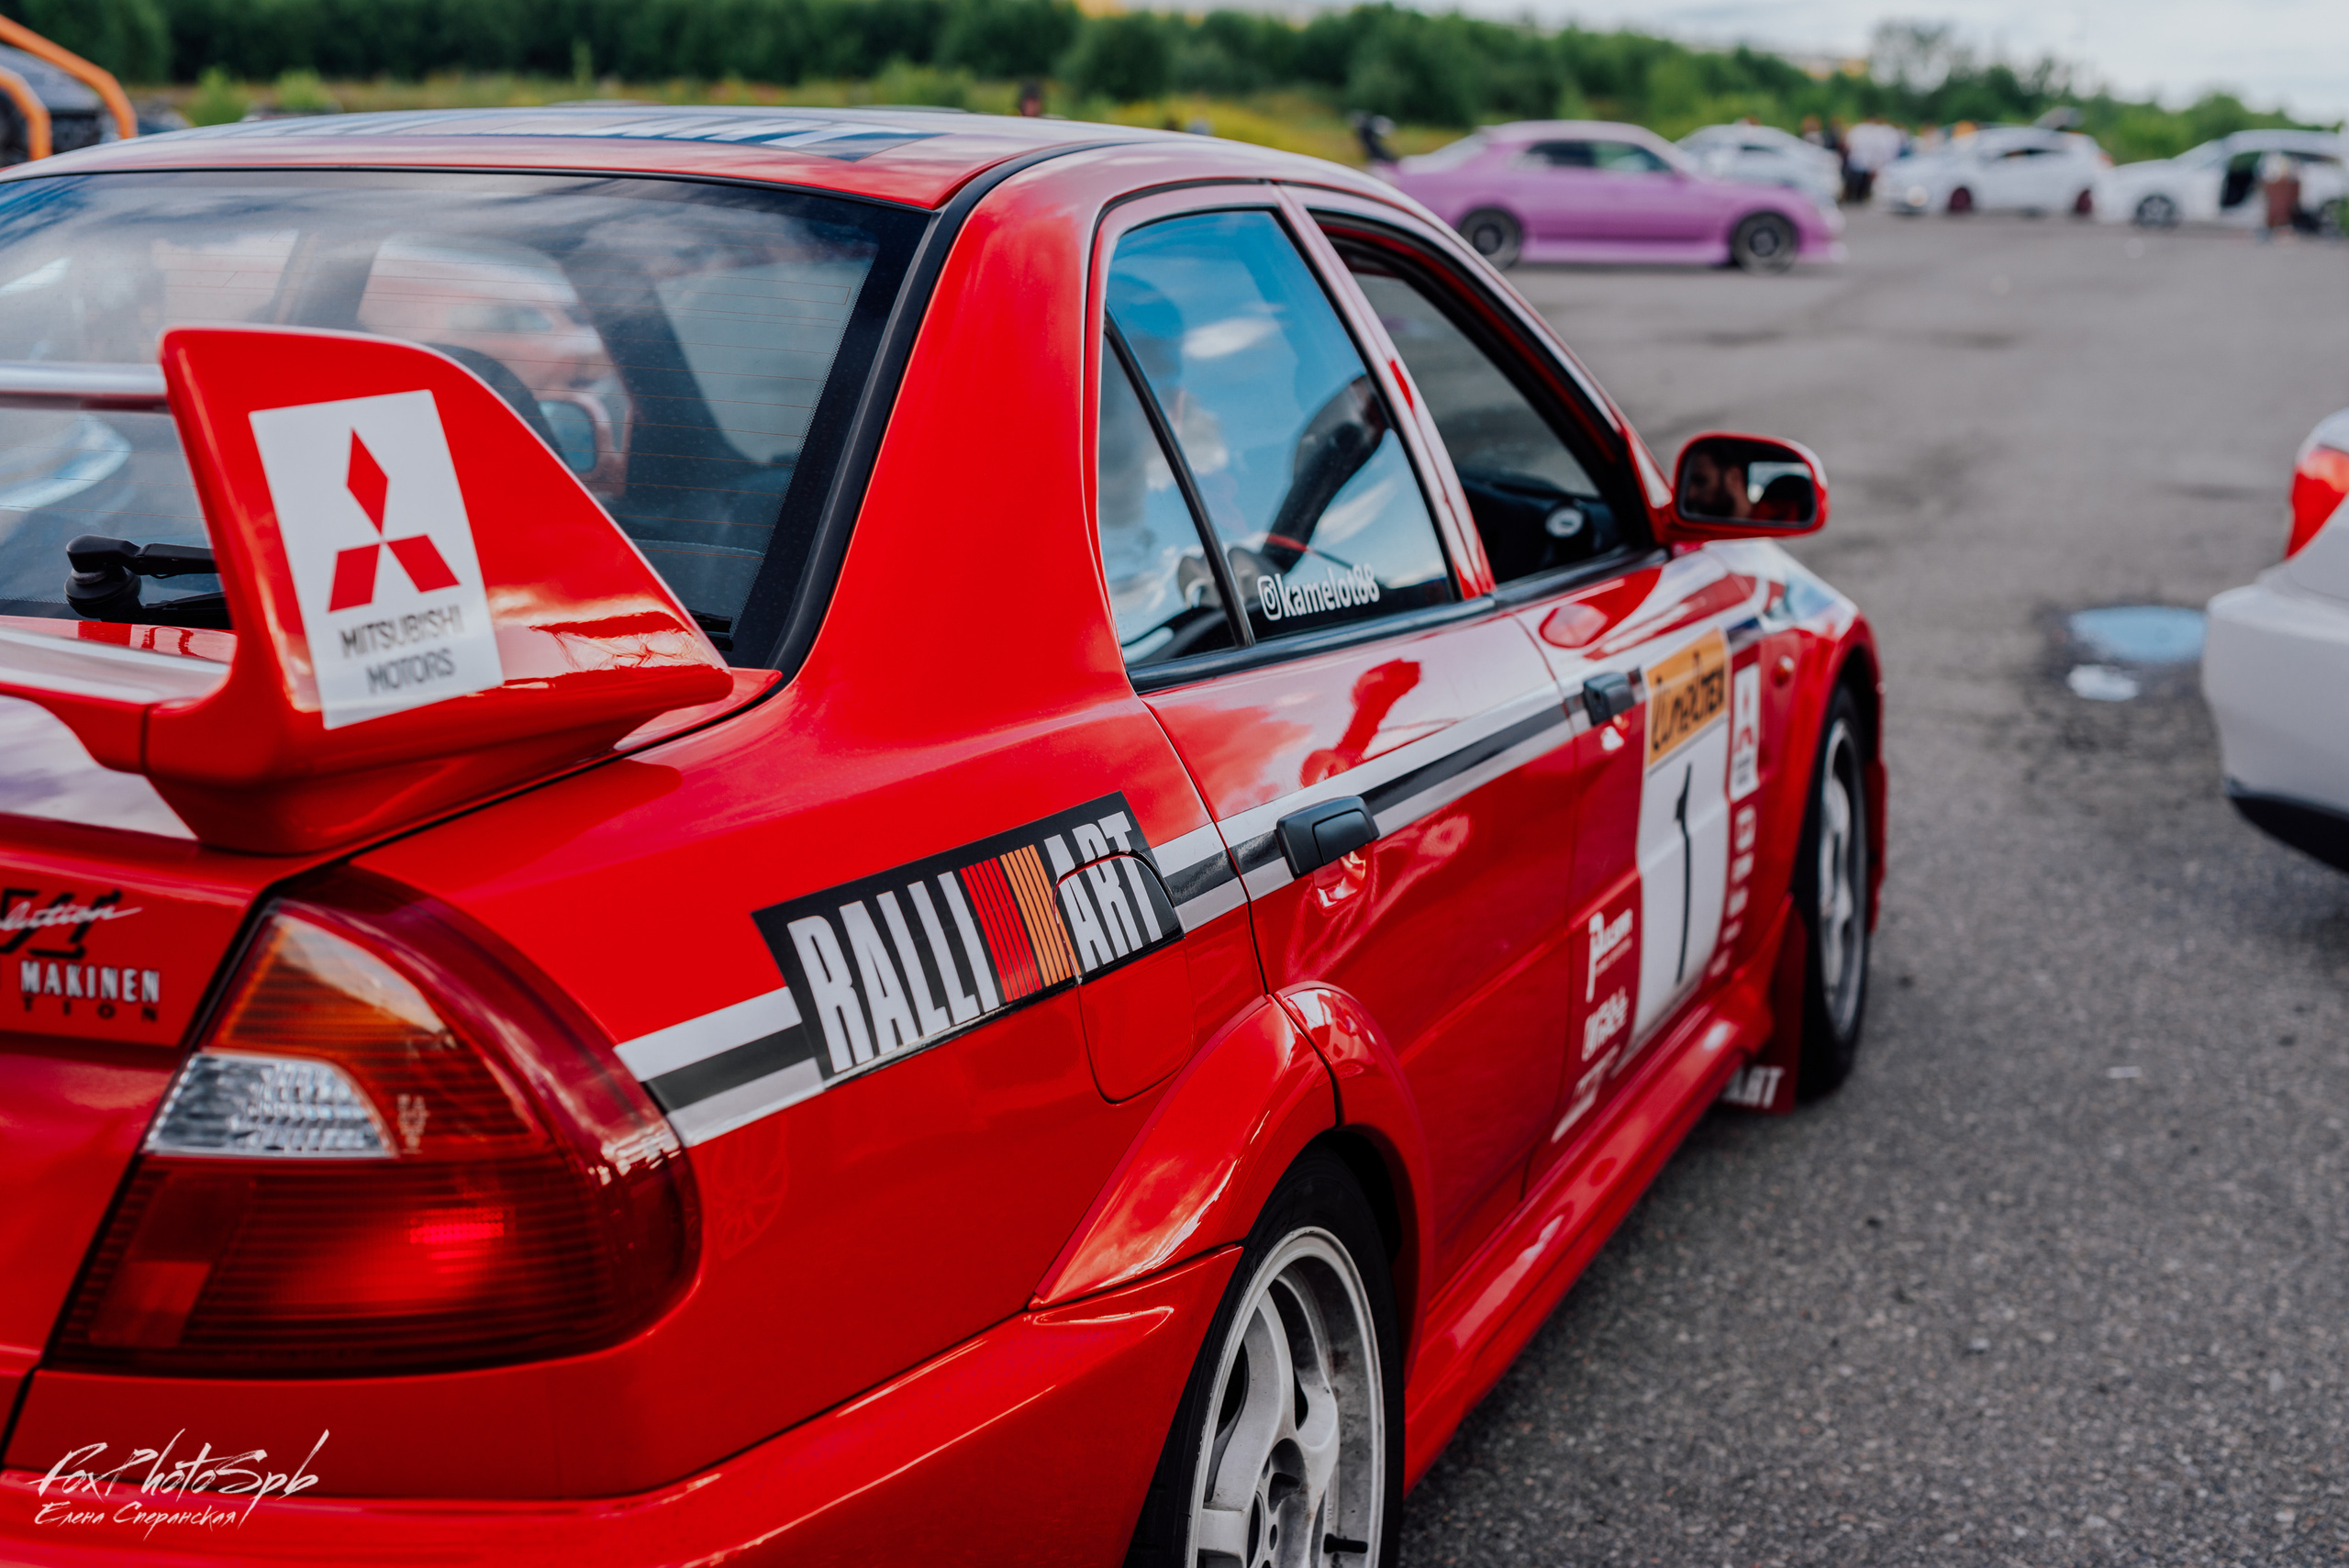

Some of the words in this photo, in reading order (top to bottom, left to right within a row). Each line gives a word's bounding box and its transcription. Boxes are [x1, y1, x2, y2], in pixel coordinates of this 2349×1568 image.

[340, 605, 465, 658] MITSUBISHI
[366, 648, 456, 695] MOTORS
[20, 960, 160, 1003] MAKINEN
